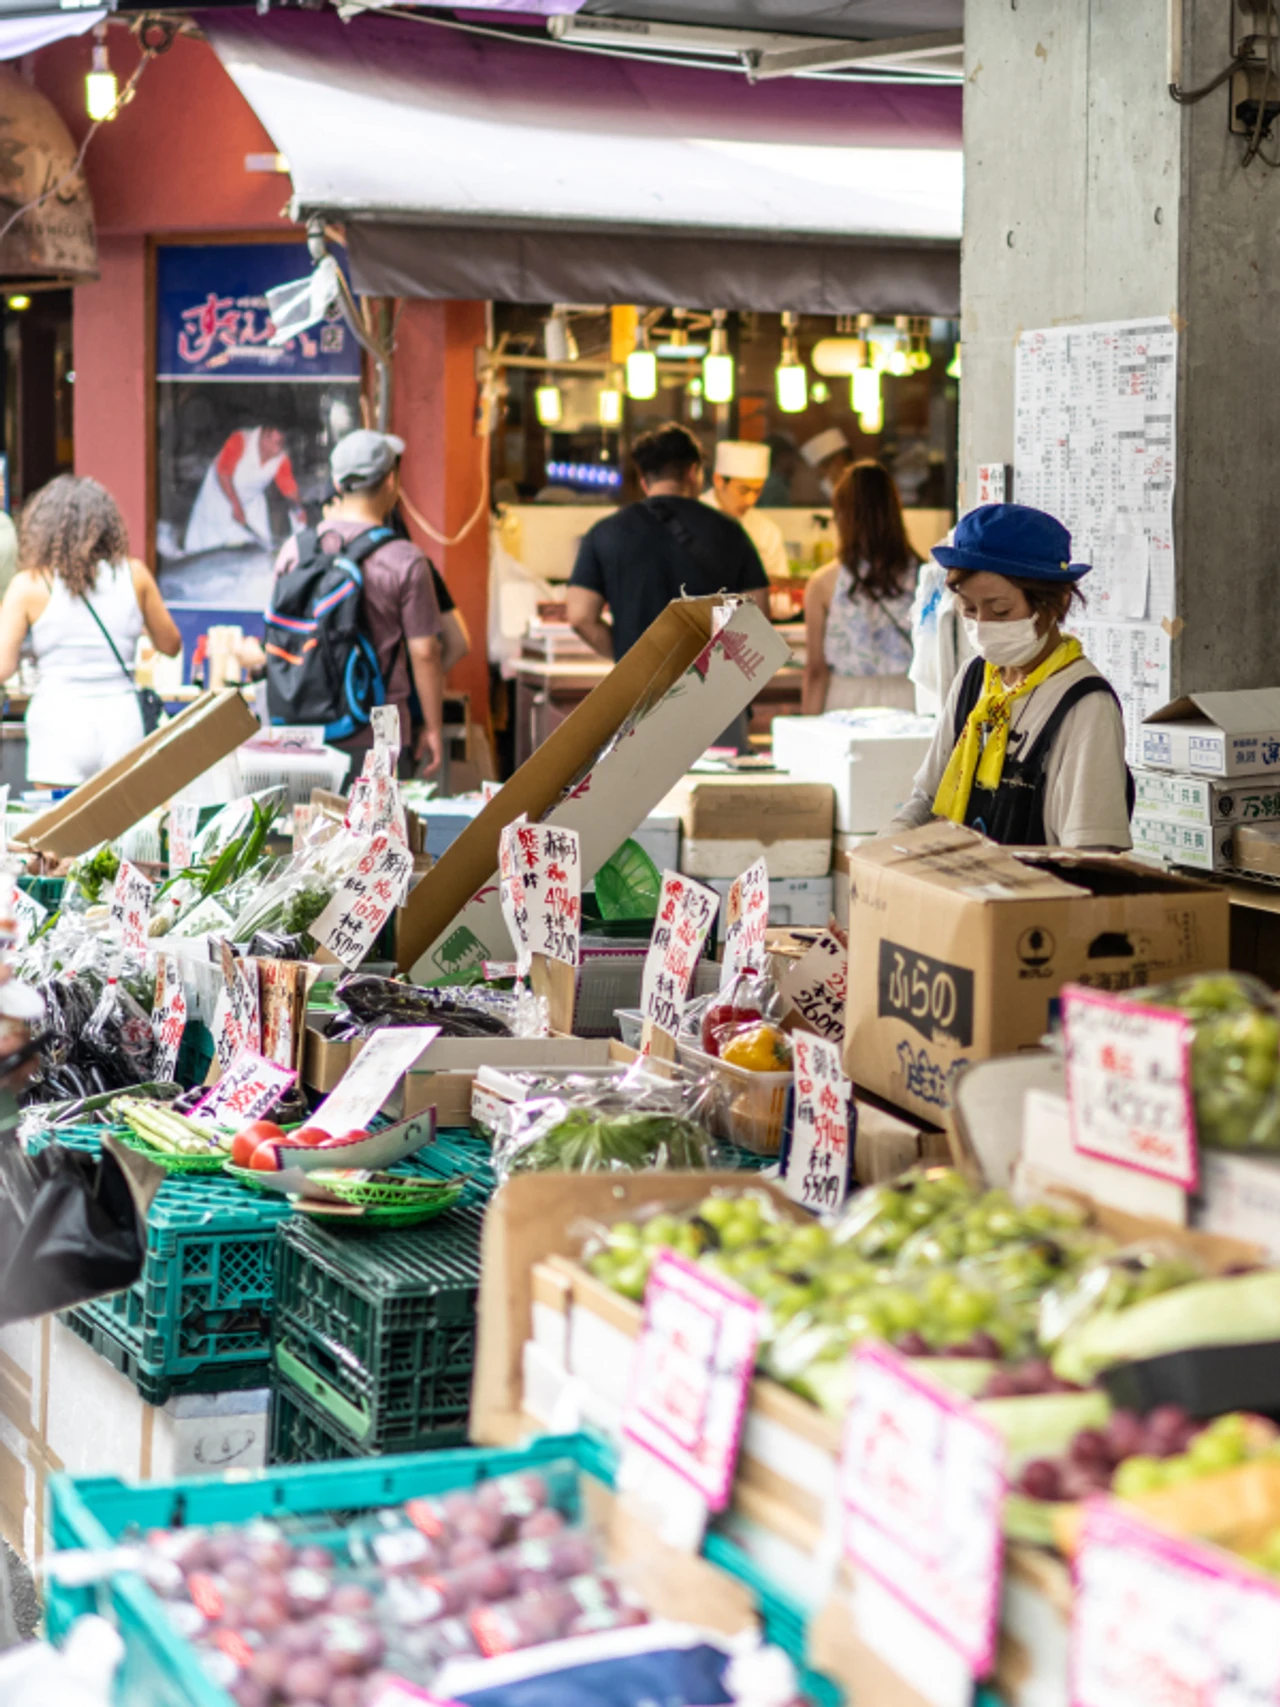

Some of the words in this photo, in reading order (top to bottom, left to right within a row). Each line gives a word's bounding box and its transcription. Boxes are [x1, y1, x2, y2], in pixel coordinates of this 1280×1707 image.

[889, 951, 957, 1027] ふらの
[791, 990, 844, 1043] 260円
[802, 1175, 839, 1207] 550円
